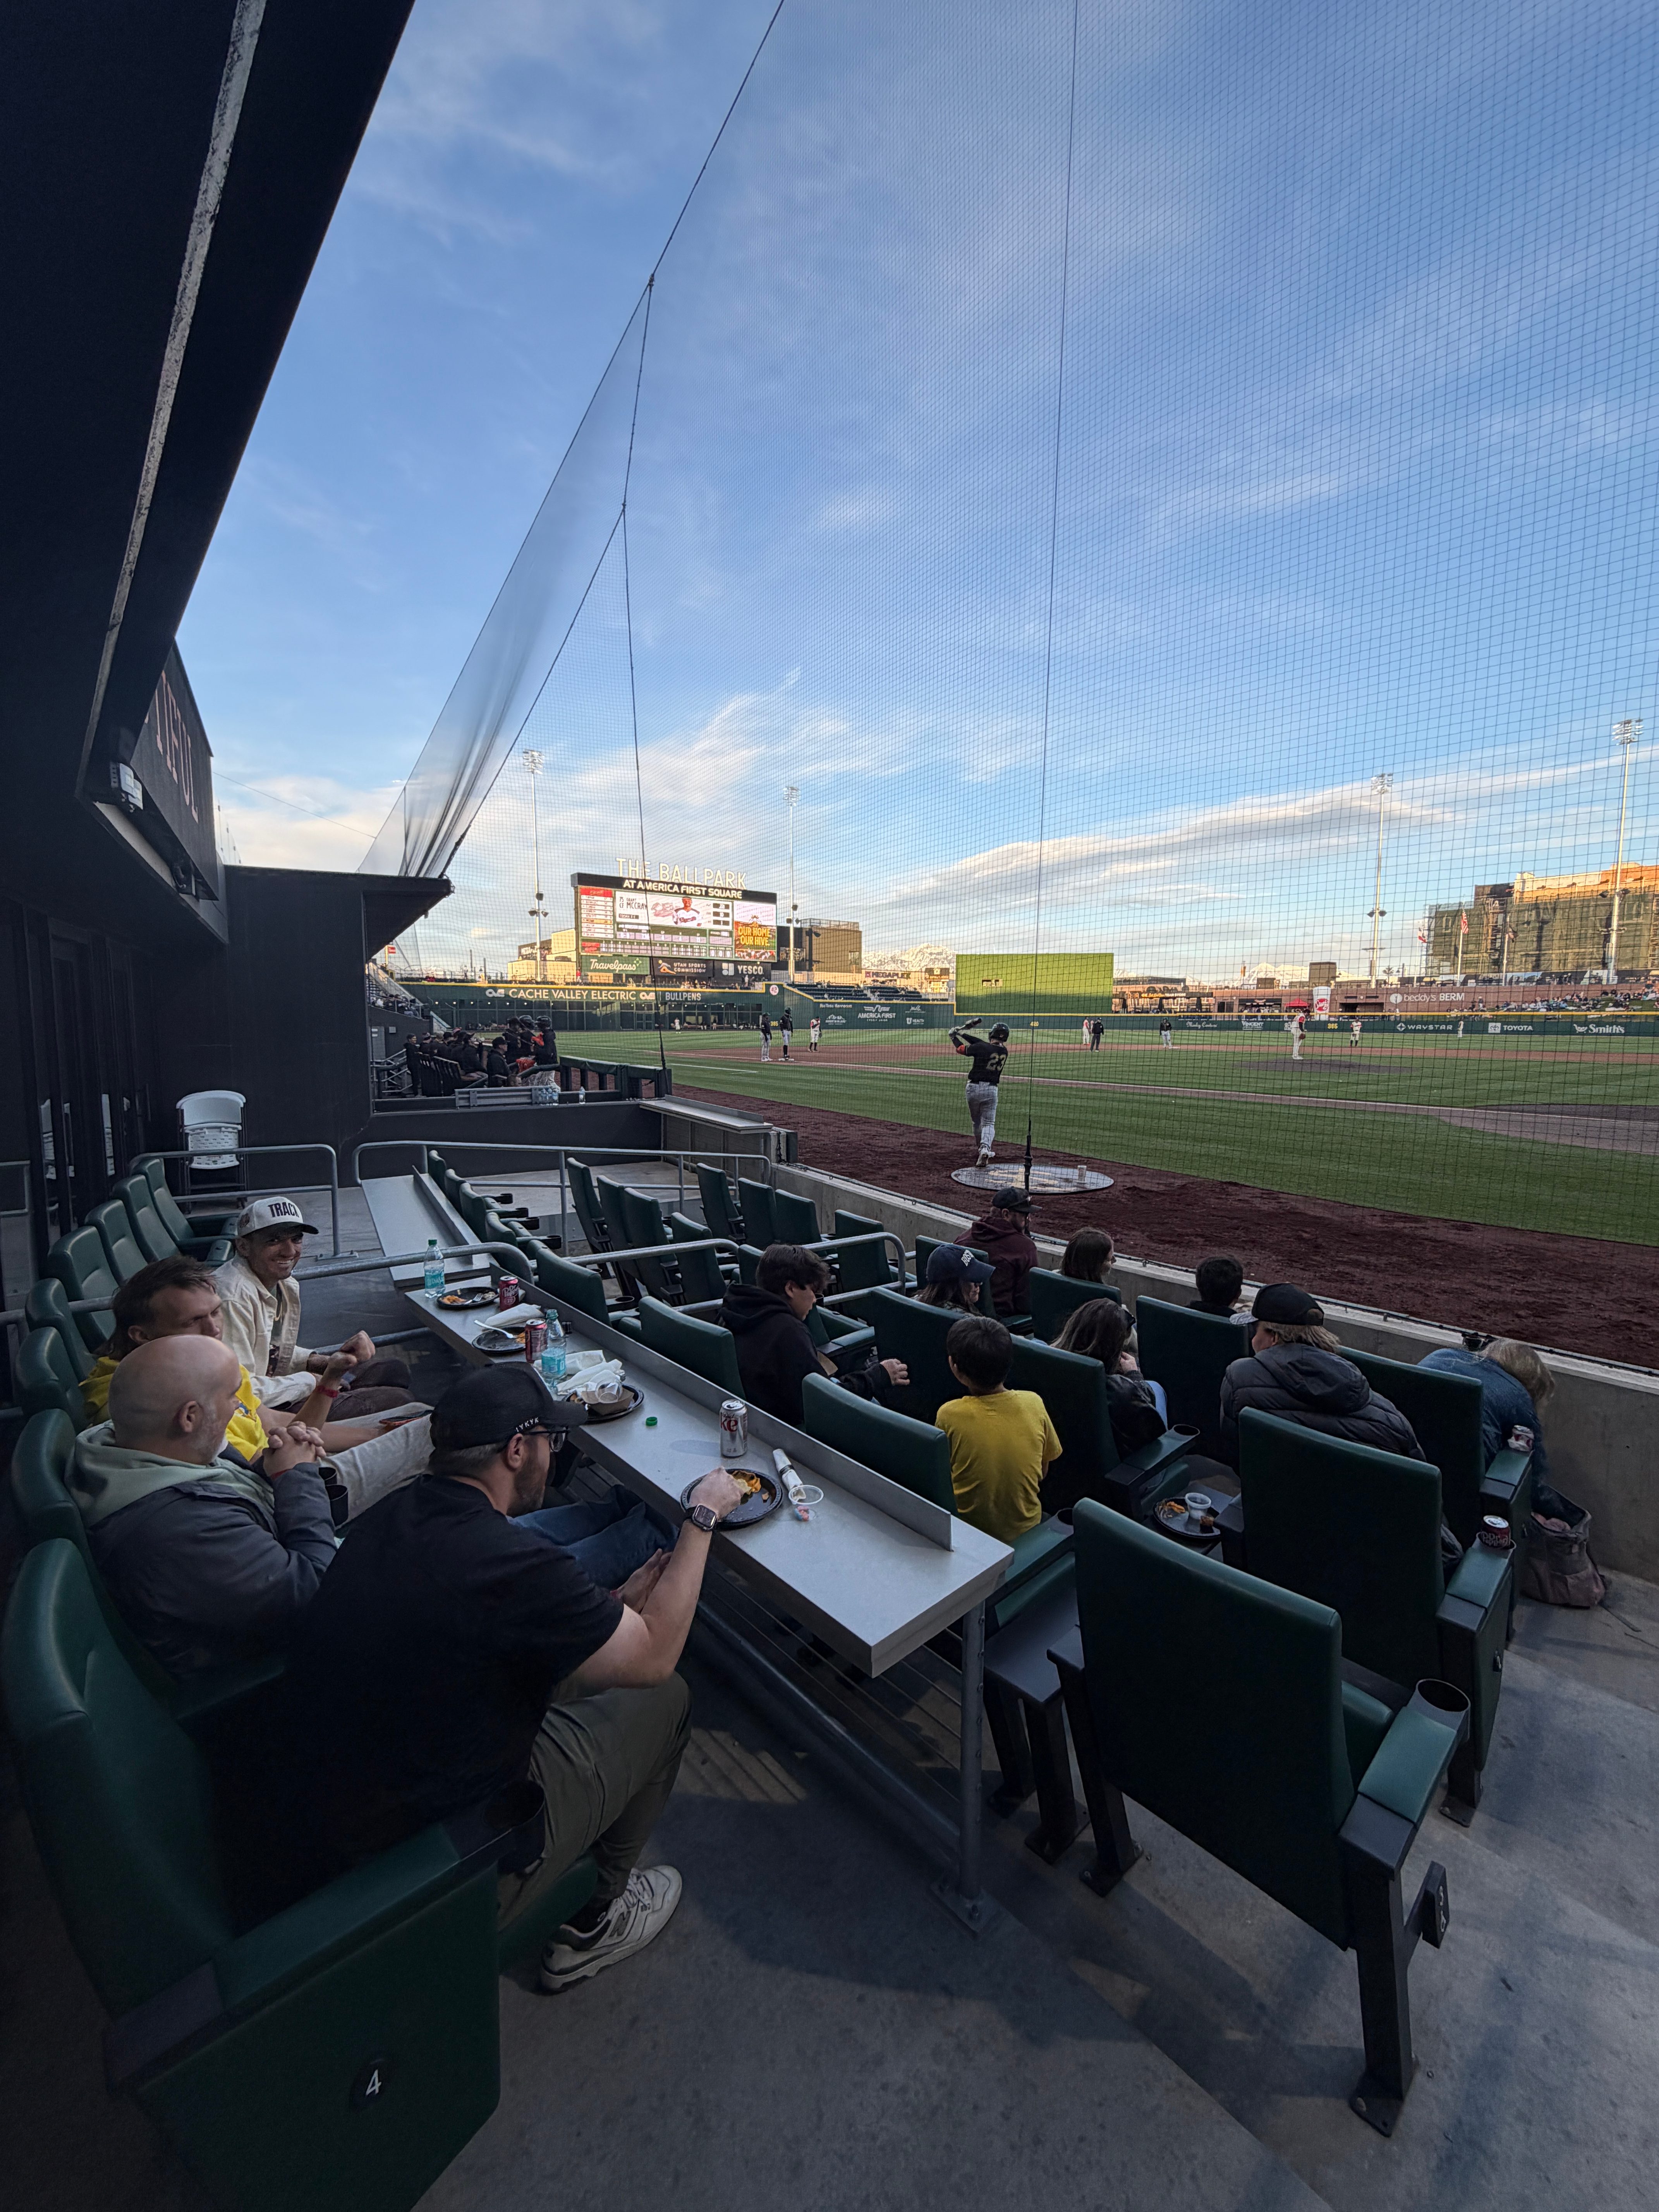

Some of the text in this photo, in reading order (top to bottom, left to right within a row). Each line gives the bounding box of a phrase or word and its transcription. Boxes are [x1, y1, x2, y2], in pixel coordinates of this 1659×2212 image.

[616, 858, 747, 890] THE BALLPARK
[623, 879, 742, 899] AT AMERICA FIRST SQUARE
[627, 902, 647, 910] MCCRAY
[738, 926, 772, 937] OUR HOME.
[740, 936, 770, 946] OUR HIVE.
[590, 958, 636, 972] Travelpass
[738, 965, 763, 975] YESCO
[872, 971, 910, 979] MEGAPLEX
[509, 989, 549, 999] CACHE
[552, 989, 588, 1000] VALLEY
[591, 991, 636, 1000] ELECTRIC
[665, 992, 702, 1001] BULLPENS
[1404, 993, 1465, 1003] beddy's BERM
[1589, 1024, 1625, 1034] Smith's
[986, 1053, 1006, 1071] 23
[516, 1417, 539, 1432] IYKYK
[721, 1412, 738, 1432] ke
[366, 2069, 382, 2095] 4
